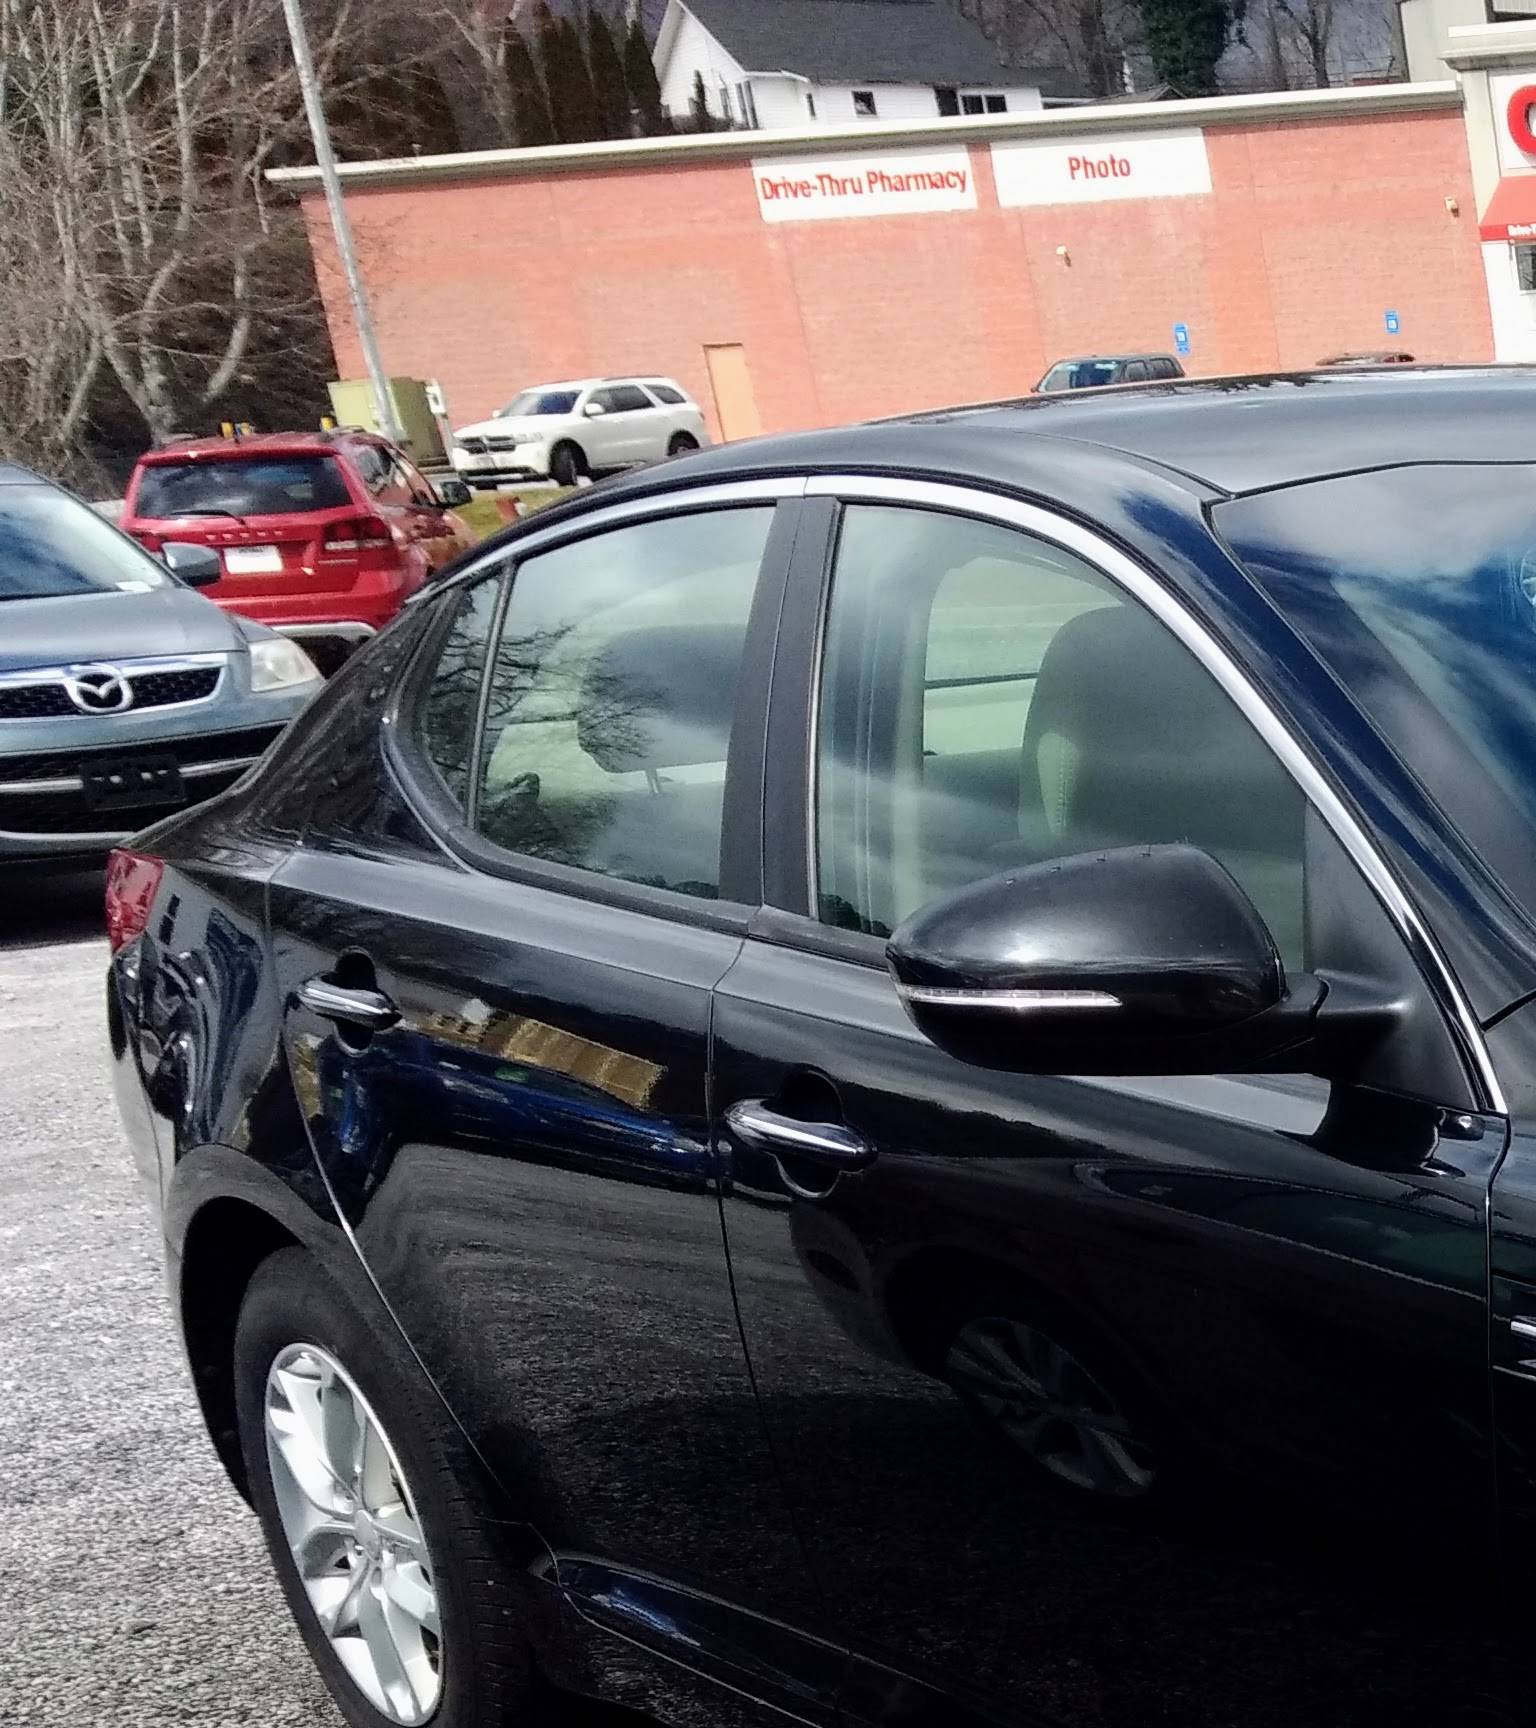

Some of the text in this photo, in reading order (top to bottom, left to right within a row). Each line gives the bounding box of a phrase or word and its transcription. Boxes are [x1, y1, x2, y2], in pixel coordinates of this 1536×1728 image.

[1069, 154, 1131, 180] Photo
[761, 167, 967, 200] Drive-Thru Pharmacy
